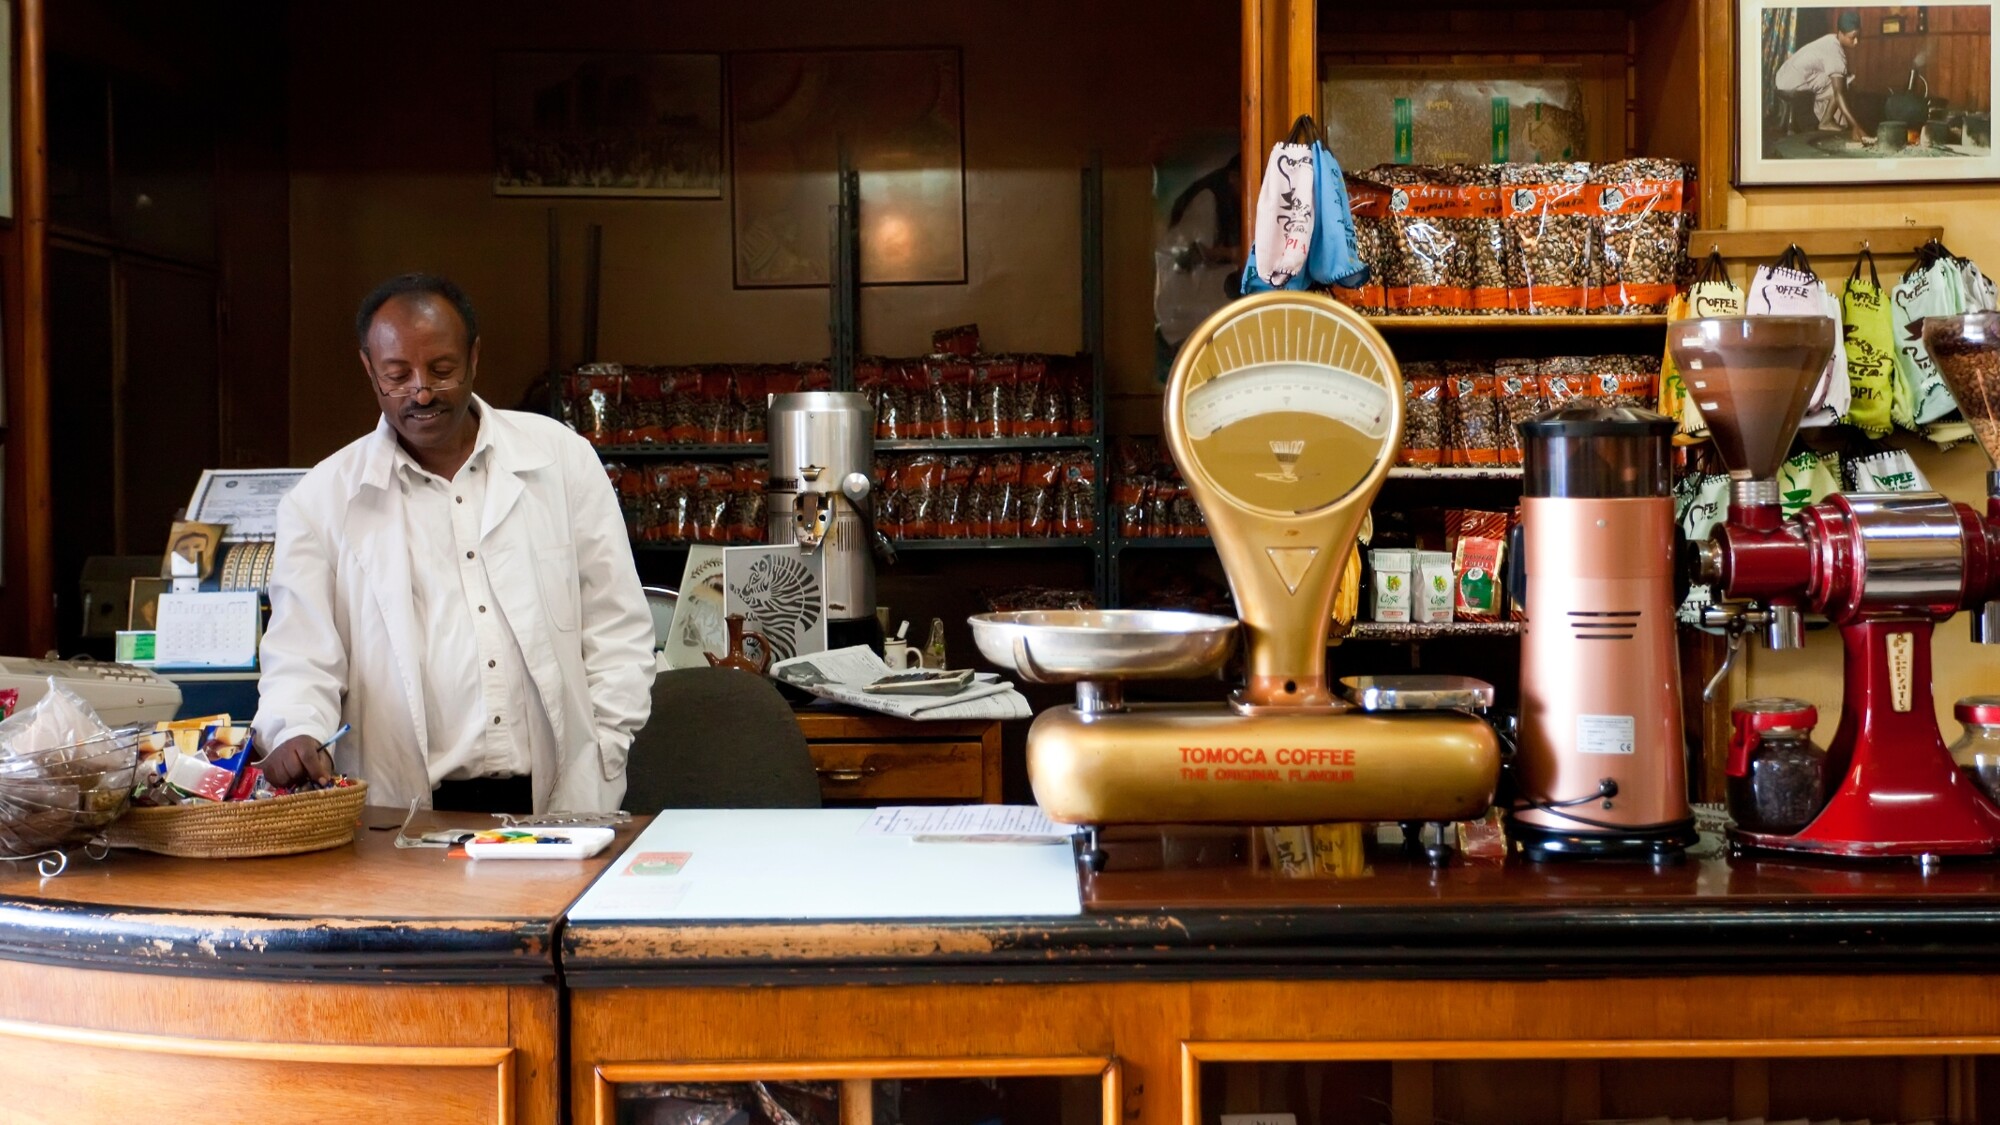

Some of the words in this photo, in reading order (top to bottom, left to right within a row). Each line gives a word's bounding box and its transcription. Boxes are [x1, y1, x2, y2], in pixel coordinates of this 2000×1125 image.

[1697, 297, 1738, 311] COFFEE
[1179, 747, 1267, 765] TOMOCA
[1275, 748, 1356, 766] COFFEE
[1179, 768, 1208, 781] THE
[1214, 768, 1283, 782] ORIGINAL
[1288, 770, 1355, 783] FLAVOUR
